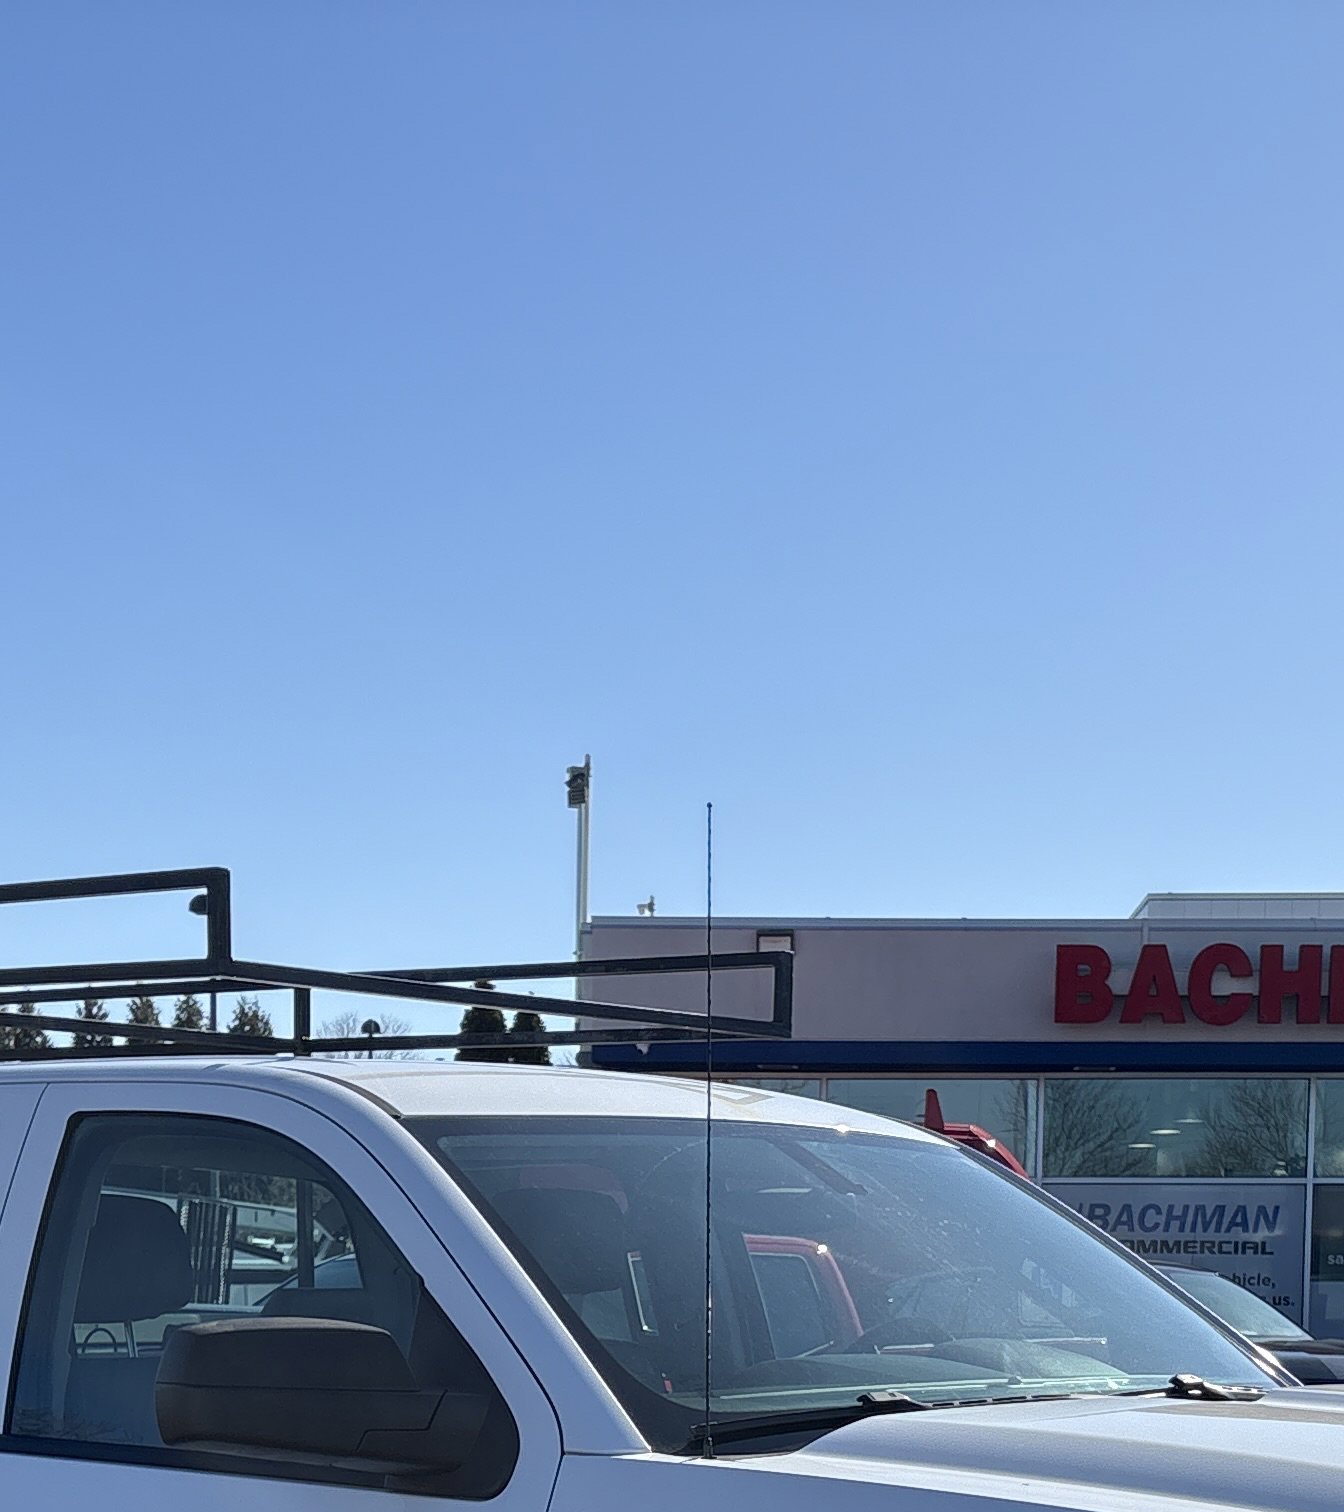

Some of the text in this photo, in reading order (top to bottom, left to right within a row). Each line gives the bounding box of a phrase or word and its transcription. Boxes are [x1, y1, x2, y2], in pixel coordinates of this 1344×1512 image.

[1086, 1202, 1280, 1235] BACHMAN
[1121, 1239, 1274, 1255] OMMERCIAL
[1232, 1272, 1276, 1289] hicle,
